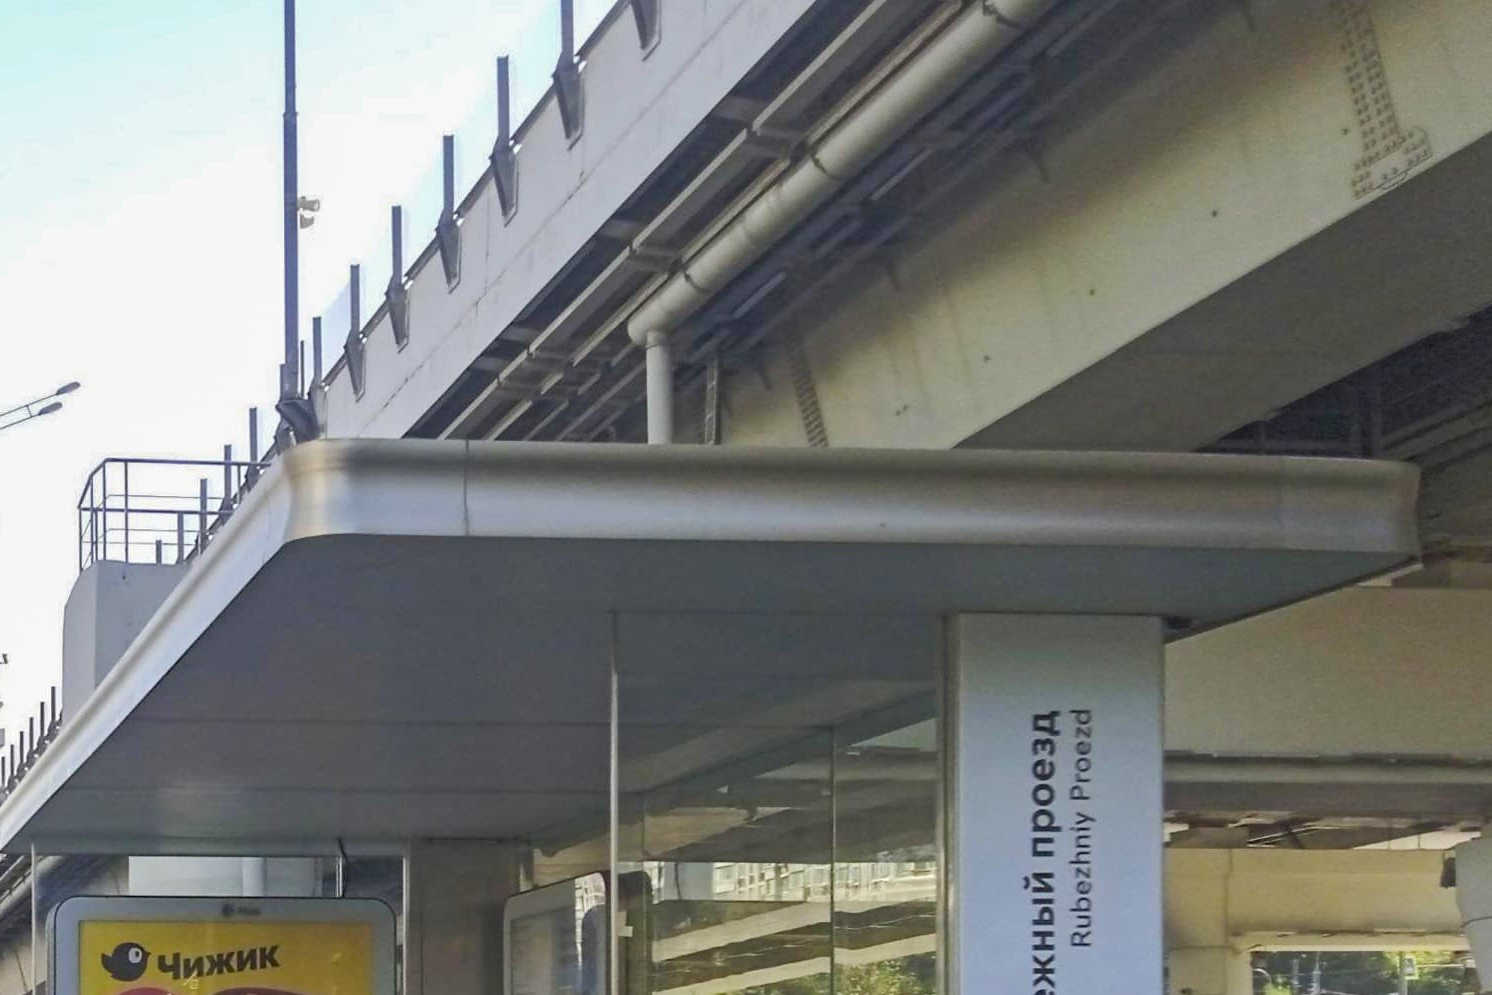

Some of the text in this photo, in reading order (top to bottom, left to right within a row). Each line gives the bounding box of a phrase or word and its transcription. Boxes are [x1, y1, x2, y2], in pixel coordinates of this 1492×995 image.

[1030, 710, 1061, 858] проезд
[1067, 709, 1096, 948] Rubezhniy Proezd
